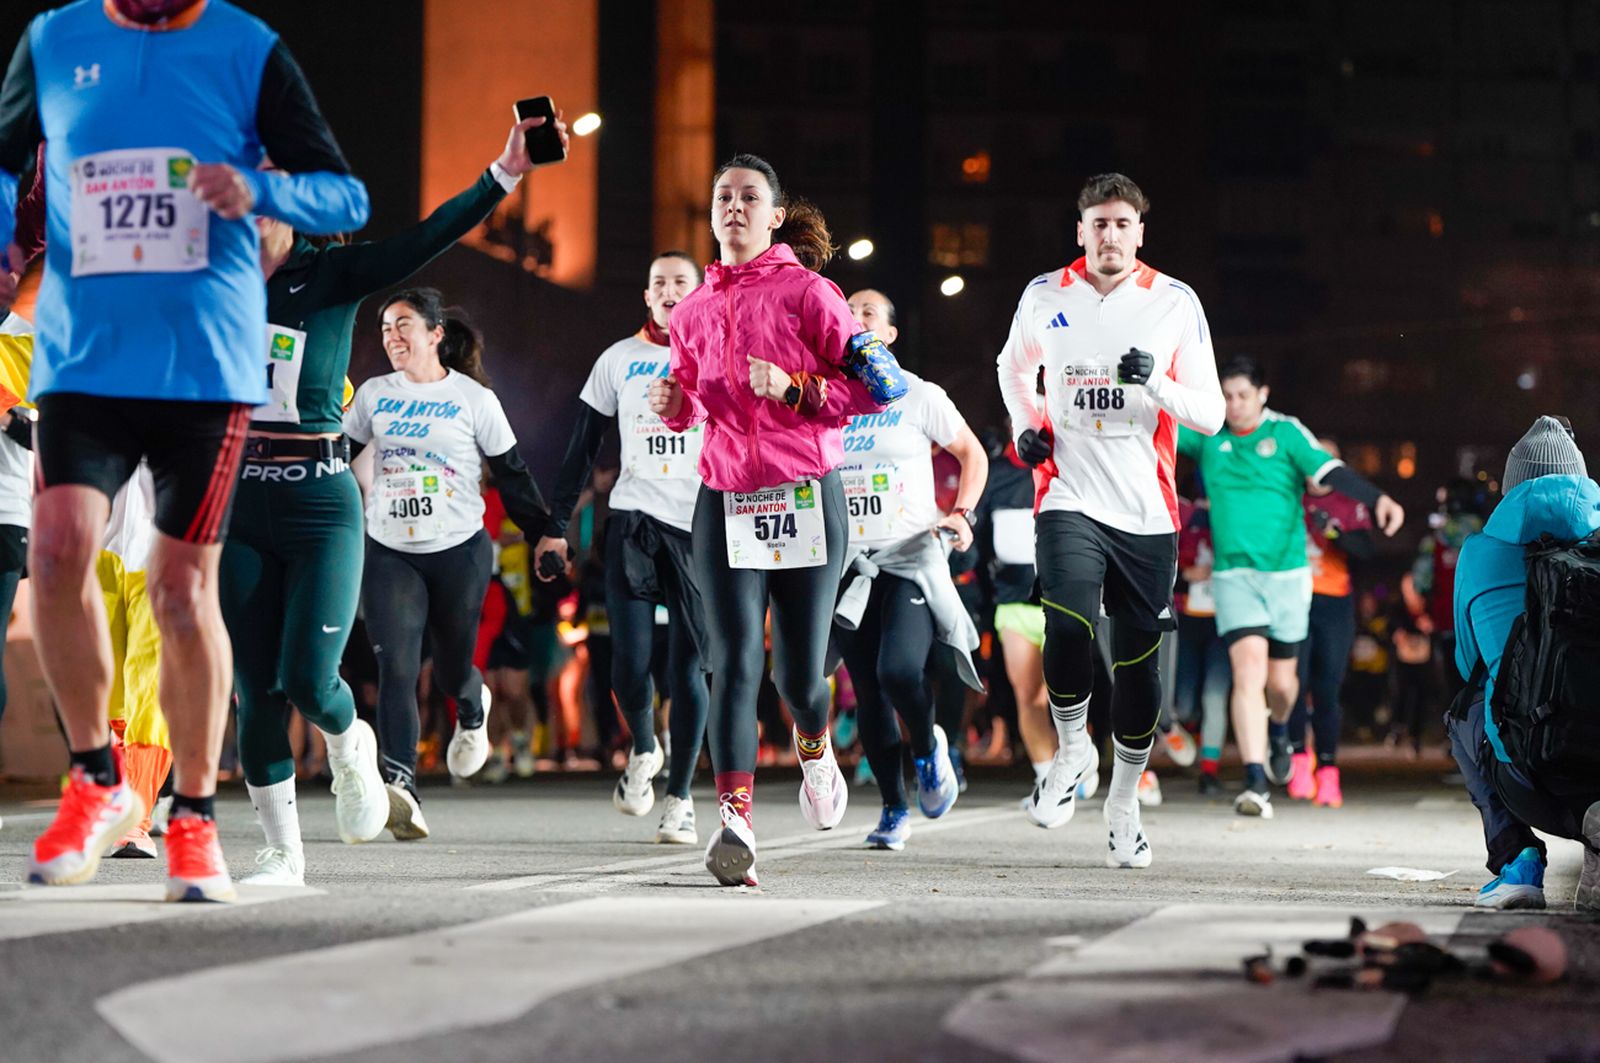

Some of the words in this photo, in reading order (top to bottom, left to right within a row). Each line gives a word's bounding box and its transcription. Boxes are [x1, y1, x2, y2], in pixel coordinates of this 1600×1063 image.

[100, 193, 176, 229] 1275
[625, 361, 658, 381] SAN
[1075, 368, 1098, 376] NOCHE
[1100, 368, 1109, 376] DE
[373, 397, 406, 416] SAN
[402, 400, 461, 419] ANTÓN
[1074, 388, 1125, 410] 4188
[384, 421, 431, 439] 2026
[646, 435, 686, 455] 1911
[844, 434, 875, 452] 026
[241, 464, 307, 482] PRO
[746, 493, 774, 503] NOCHE
[774, 491, 786, 501] DE
[848, 495, 882, 517] 570
[389, 497, 433, 519] 4903
[736, 504, 755, 515] SAN
[754, 513, 798, 541] 574
